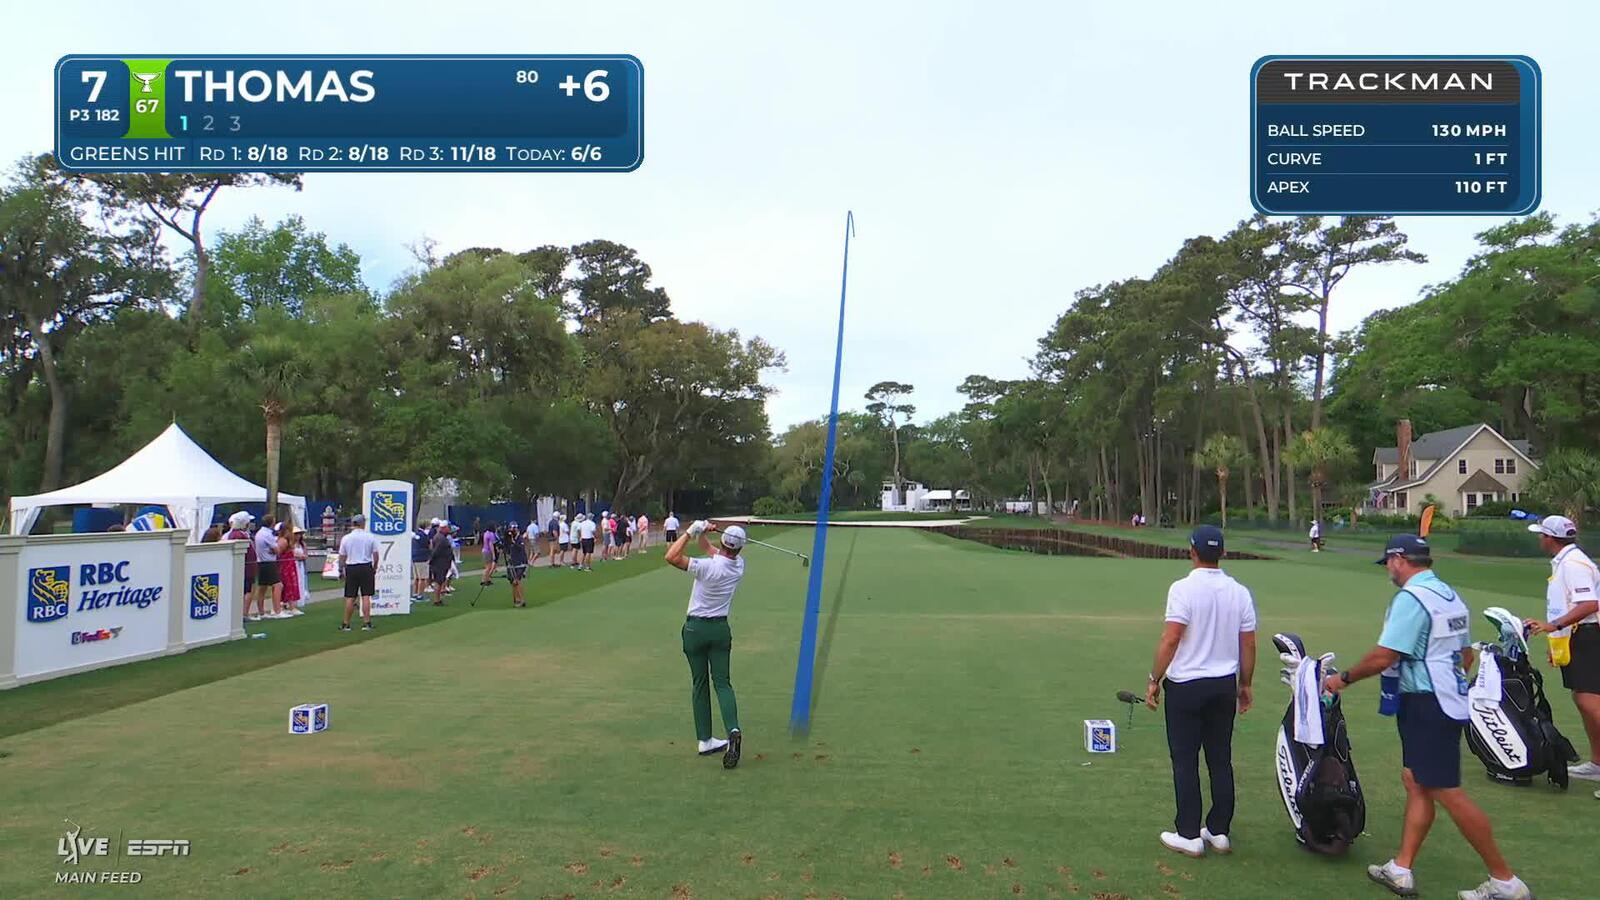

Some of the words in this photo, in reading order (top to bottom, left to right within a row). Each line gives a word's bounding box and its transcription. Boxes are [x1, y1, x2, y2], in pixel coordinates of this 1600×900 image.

[374, 521, 406, 532] RBC
[380, 541, 395, 561] 7
[80, 561, 130, 586] RBC
[377, 564, 394, 574] AR
[396, 564, 403, 573] 3
[77, 585, 163, 612] Heritage
[33, 603, 67, 619] RBC
[194, 603, 217, 617] RBC
[1472, 702, 1522, 764] Titleist
